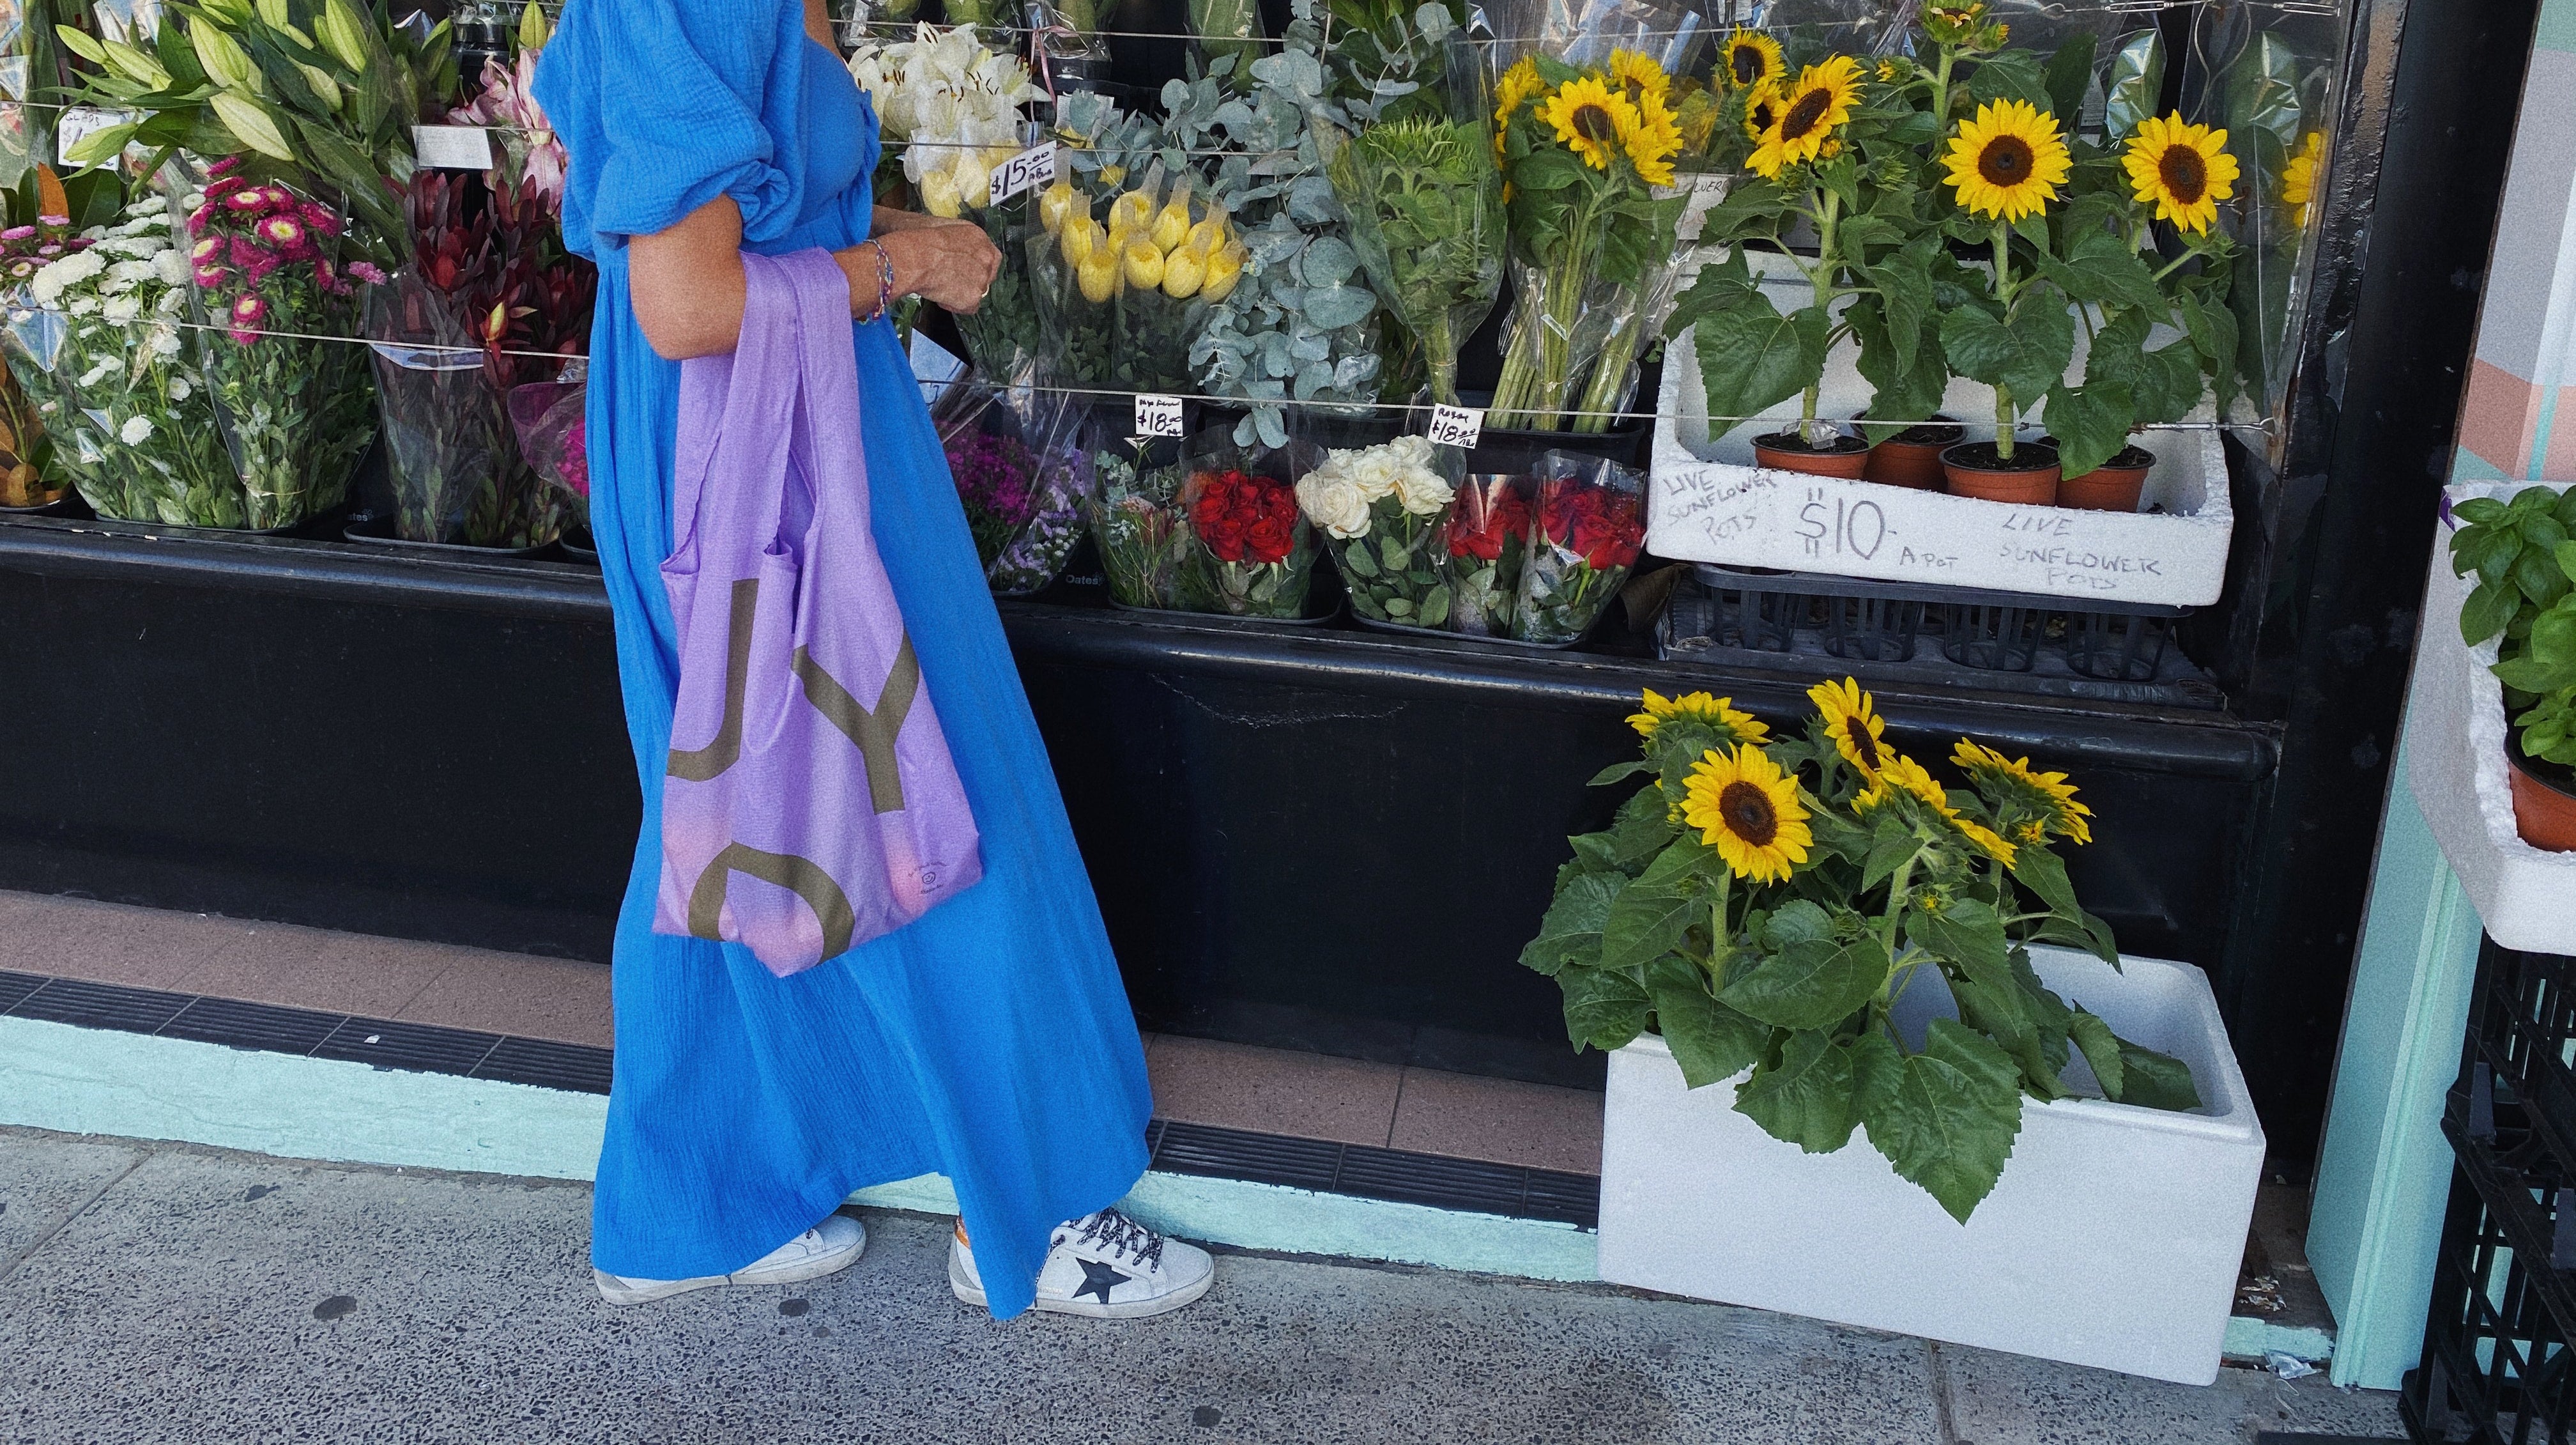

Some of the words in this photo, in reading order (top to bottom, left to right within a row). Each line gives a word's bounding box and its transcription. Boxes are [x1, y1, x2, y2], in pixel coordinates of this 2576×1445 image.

[1663, 469, 1715, 496] LIVE
[1667, 471, 1777, 527] SUNFLOWER
[347, 513, 369, 522] ates
[2002, 513, 2074, 536] LIVE
[1899, 546, 1915, 566] A
[1999, 544, 2162, 576] SUNFLOWER
[1066, 575, 1098, 585] Oates
